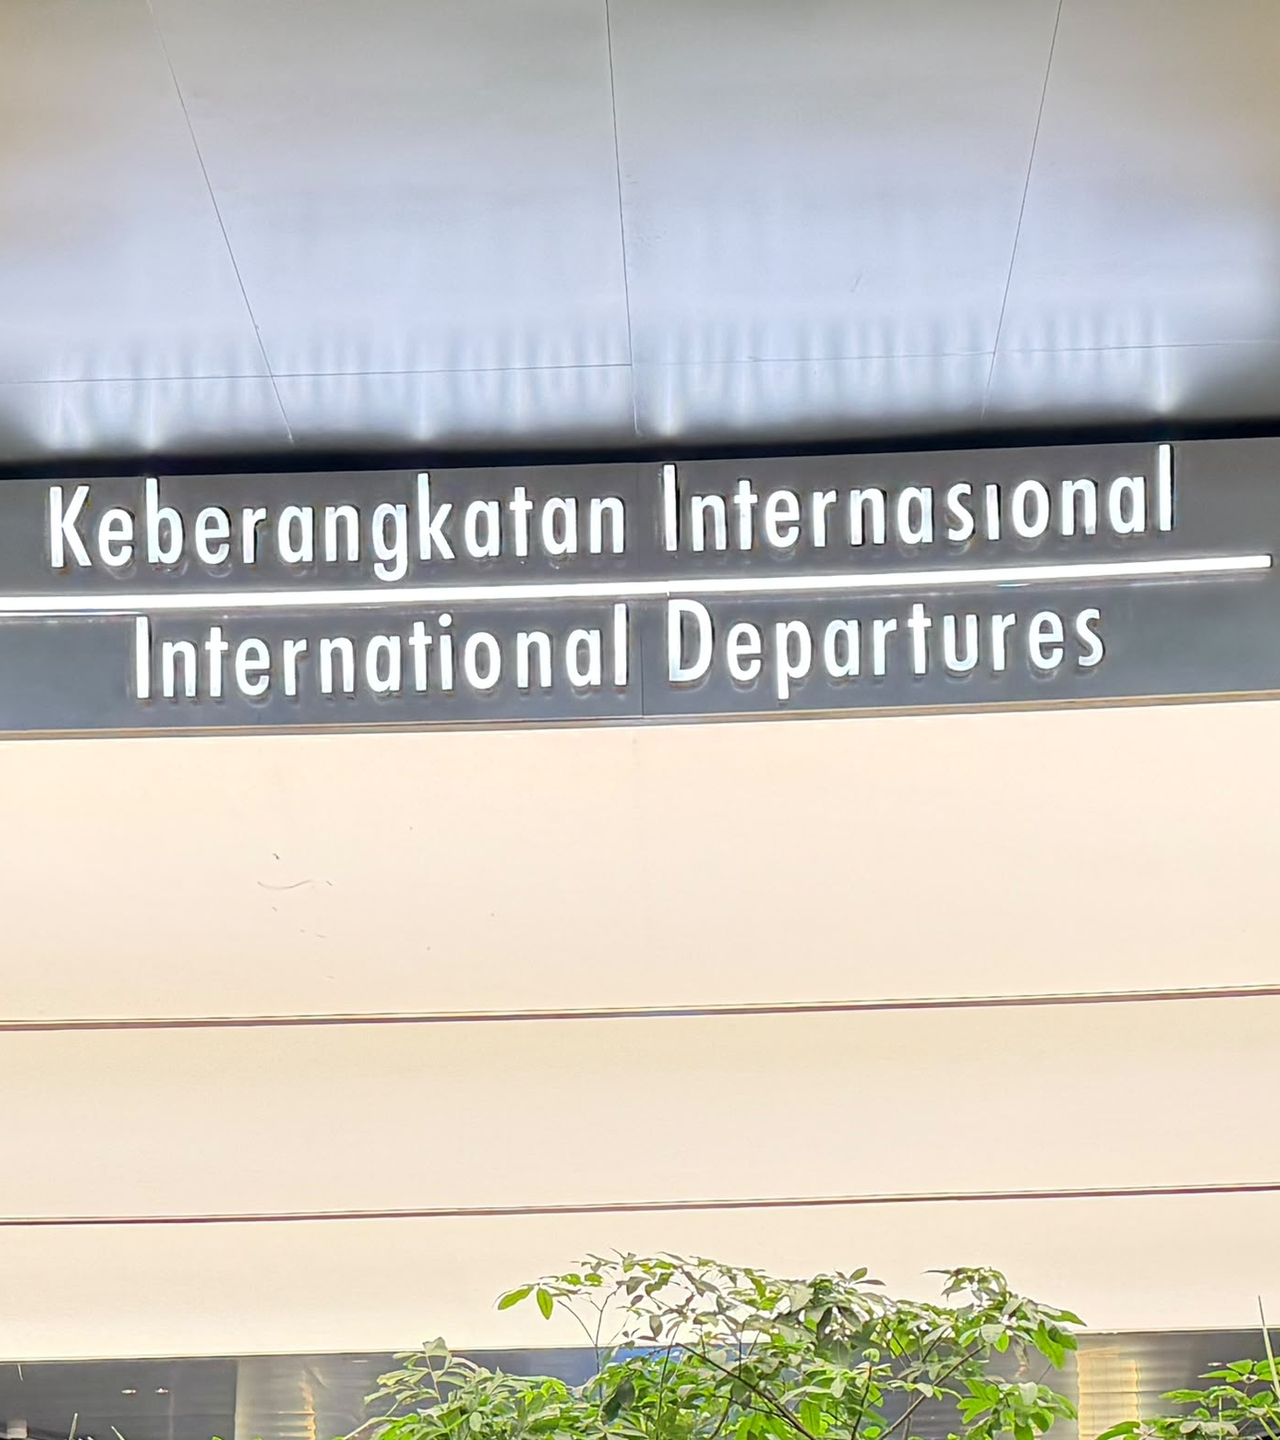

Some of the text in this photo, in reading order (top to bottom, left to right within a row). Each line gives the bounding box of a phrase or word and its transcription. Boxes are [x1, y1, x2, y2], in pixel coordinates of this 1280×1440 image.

[47, 443, 1174, 583] Keberangkatan Internasional
[133, 597, 1105, 701] International Departures
